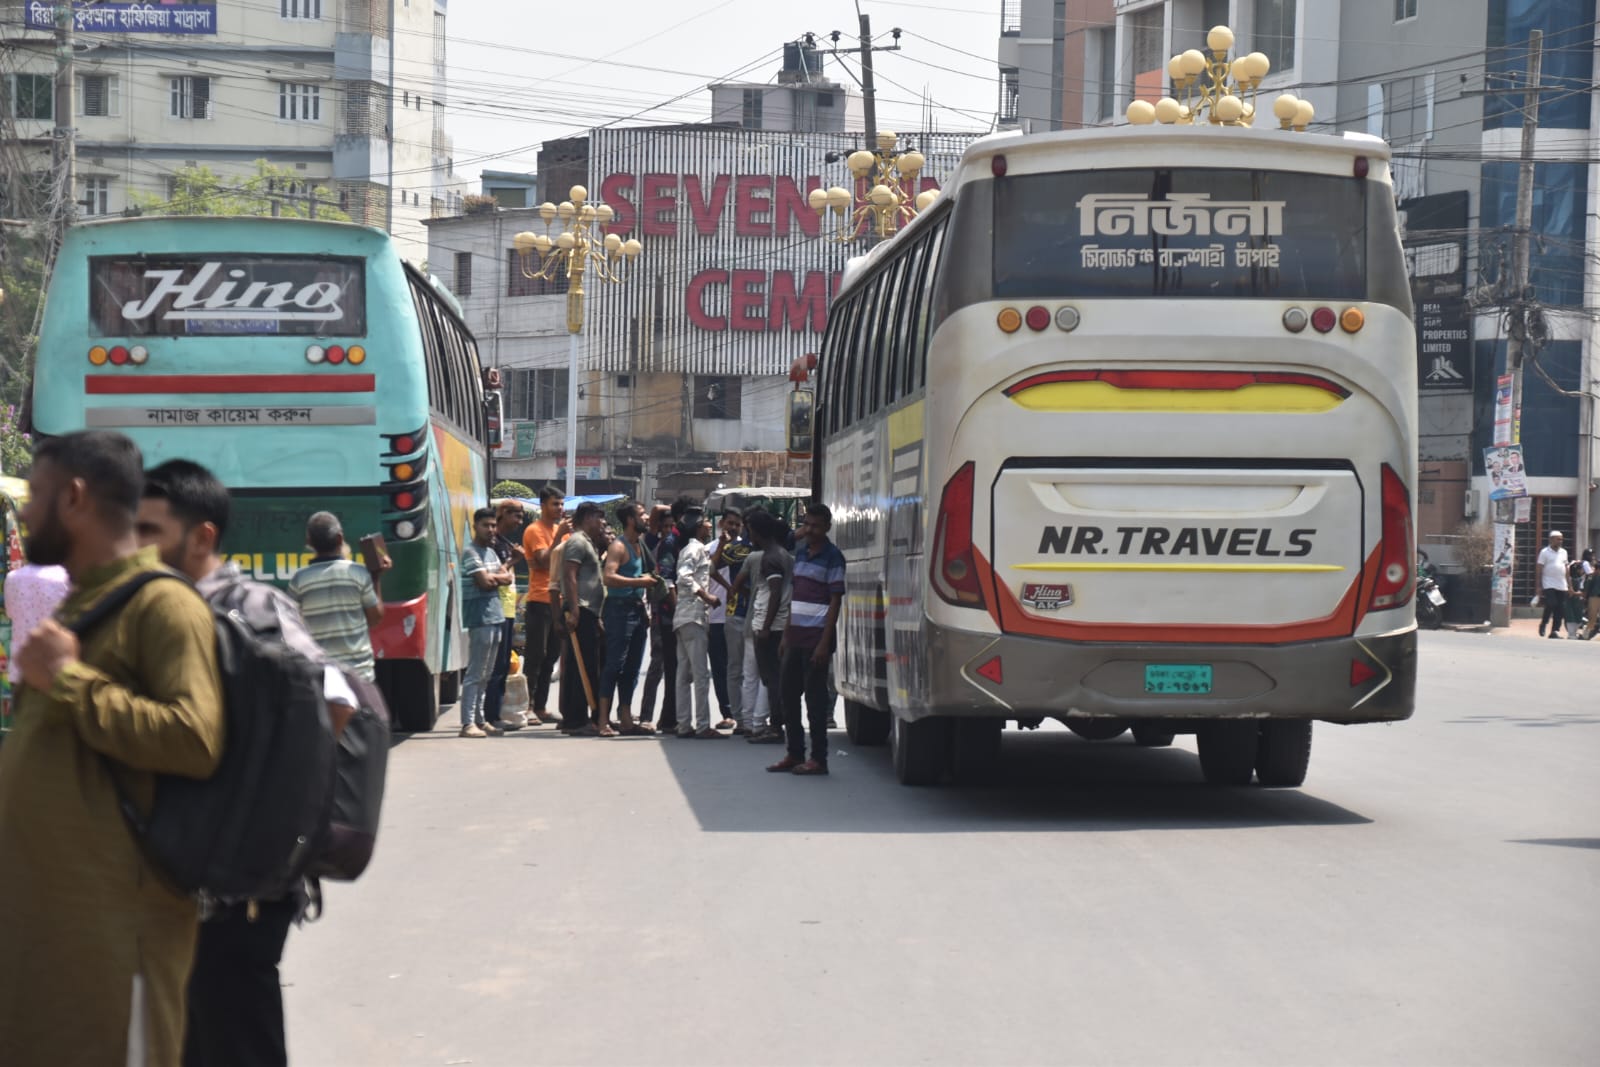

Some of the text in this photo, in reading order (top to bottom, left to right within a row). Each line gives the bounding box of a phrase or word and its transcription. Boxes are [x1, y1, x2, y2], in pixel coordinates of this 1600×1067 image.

[173, 8, 209, 30] মাদ্রাসা
[599, 172, 822, 237] SEVEN
[122, 262, 344, 321] Hino
[684, 269, 842, 332] CEM
[1423, 329, 1467, 340] PROPERTIES
[1423, 343, 1451, 353] LIMITED
[146, 408, 313, 424] নামাজ কায়েম করুন
[1030, 585, 1062, 600] Hino
[1037, 601, 1056, 609] AK
